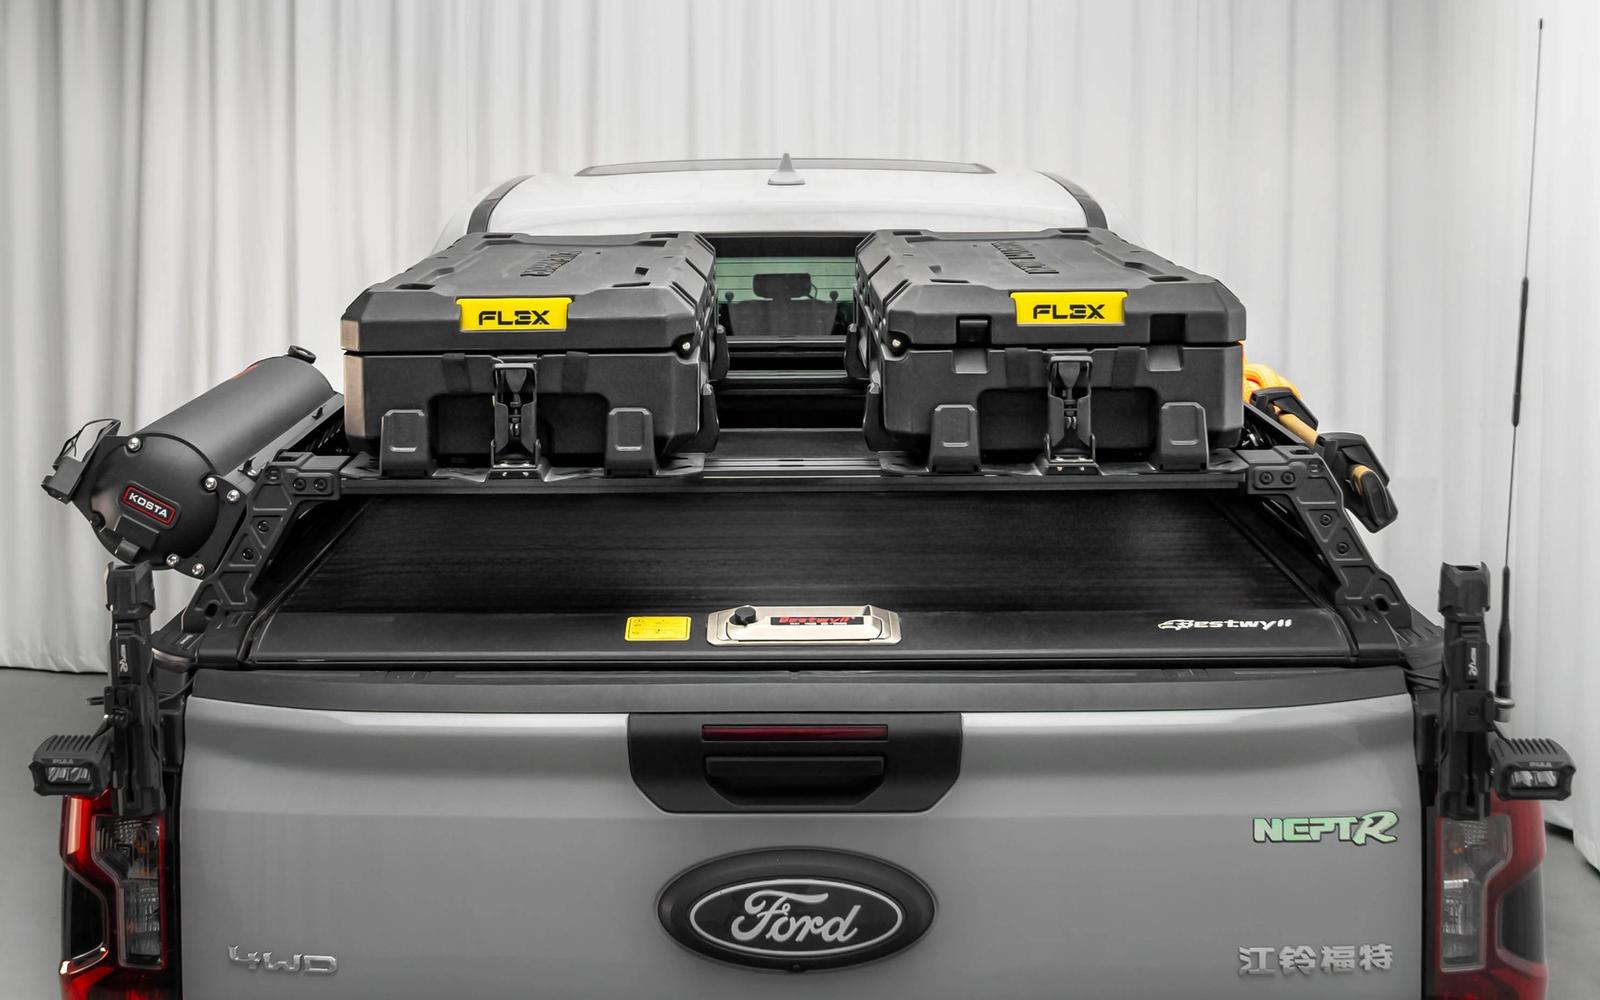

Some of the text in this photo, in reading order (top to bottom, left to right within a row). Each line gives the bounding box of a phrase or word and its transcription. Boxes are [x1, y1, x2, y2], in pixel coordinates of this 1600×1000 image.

[477, 309, 551, 326] FLEX
[1033, 304, 1106, 321] FLEX
[128, 491, 168, 519] KOSTA
[1252, 811, 1400, 846] NEPTR
[730, 888, 863, 943] Ford
[228, 944, 338, 974] 4WD
[1238, 943, 1393, 975] 江铃福特
